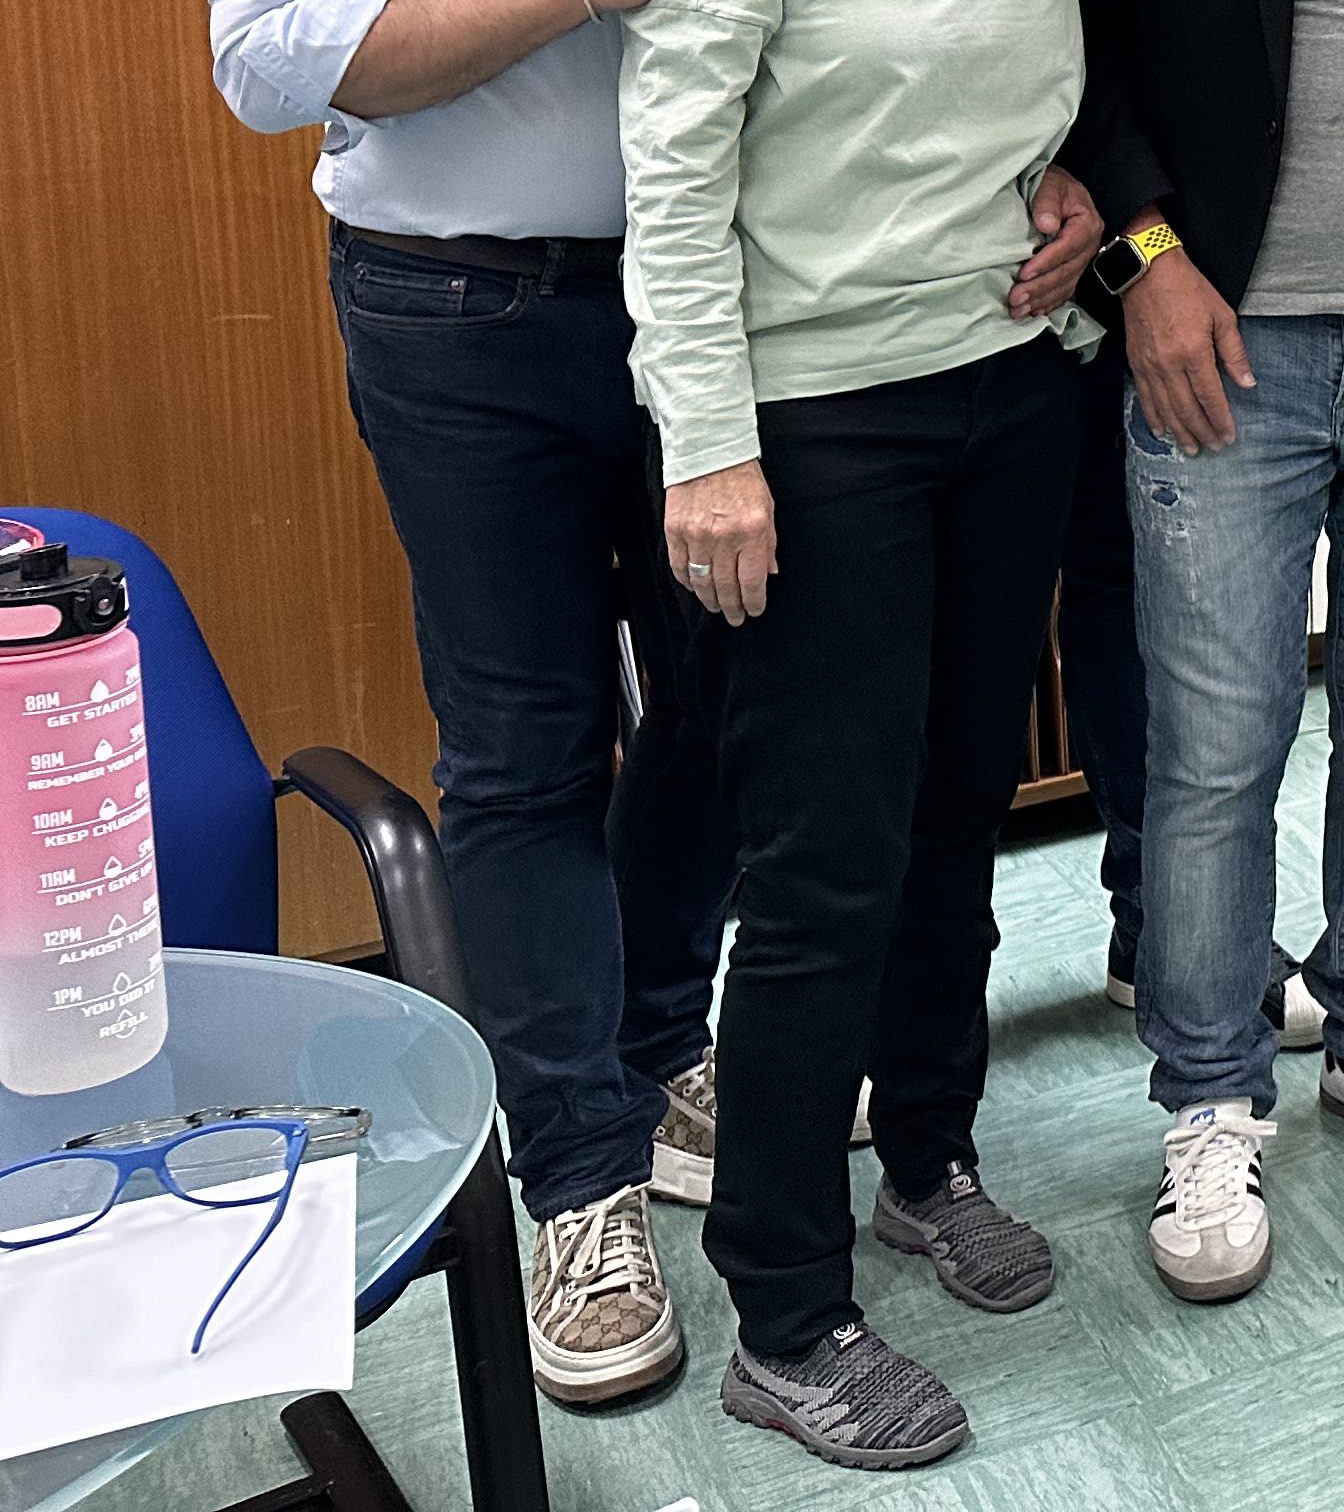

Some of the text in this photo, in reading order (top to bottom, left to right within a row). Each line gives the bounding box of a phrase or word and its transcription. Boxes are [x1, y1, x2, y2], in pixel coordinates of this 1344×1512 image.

[25, 691, 60, 712] 8AM
[47, 711, 81, 728] GET
[30, 750, 65, 771] 9AM
[28, 766, 105, 791] REMEMBER
[32, 809, 73, 830] 10AM
[44, 829, 89, 848] KEEP
[40, 868, 76, 889] 11AM
[55, 884, 106, 906] DON'T
[108, 869, 140, 893] GIVE
[43, 926, 82, 947] 12PM
[58, 938, 125, 966] ALMOST
[52, 986, 83, 1006] 1PM
[81, 997, 116, 1018] YOU
[118, 987, 144, 1007] DID
[100, 1010, 149, 1039] REFILL
